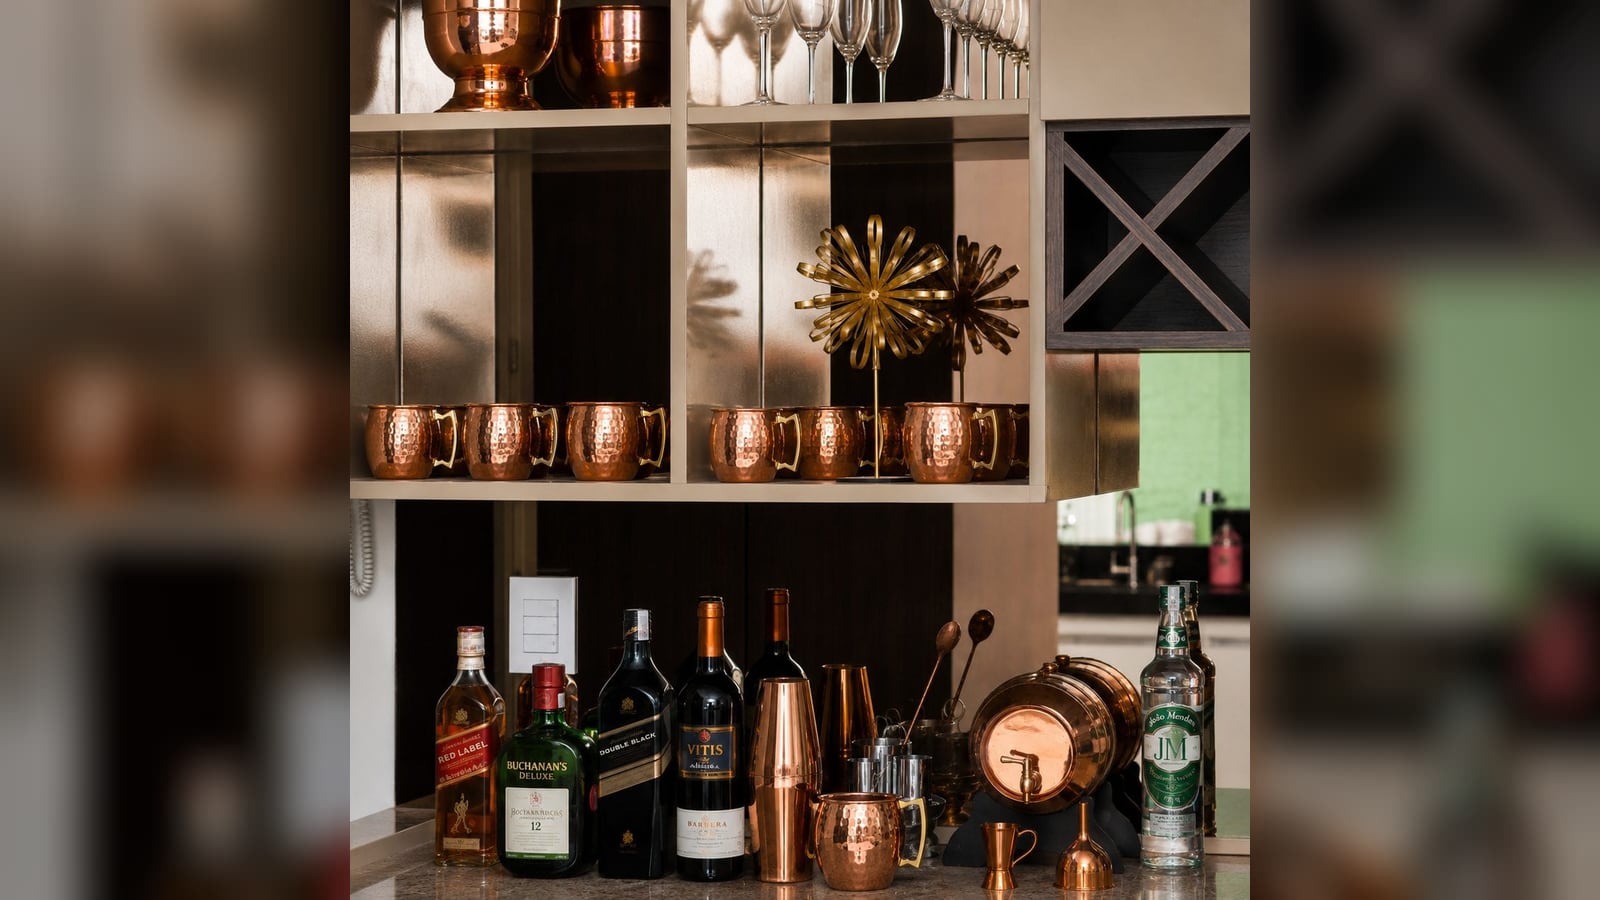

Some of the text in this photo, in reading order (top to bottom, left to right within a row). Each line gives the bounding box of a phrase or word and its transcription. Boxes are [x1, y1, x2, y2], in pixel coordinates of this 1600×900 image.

[599, 732, 657, 756] DOUBLE BLACK
[687, 743, 724, 756] VITIS
[1153, 737, 1187, 760] JM
[438, 752, 456, 764] RED
[457, 741, 489, 757] LABEL
[507, 761, 568, 771] BUCHANAN'S
[519, 772, 554, 780] DELUXE
[531, 822, 541, 831] 12
